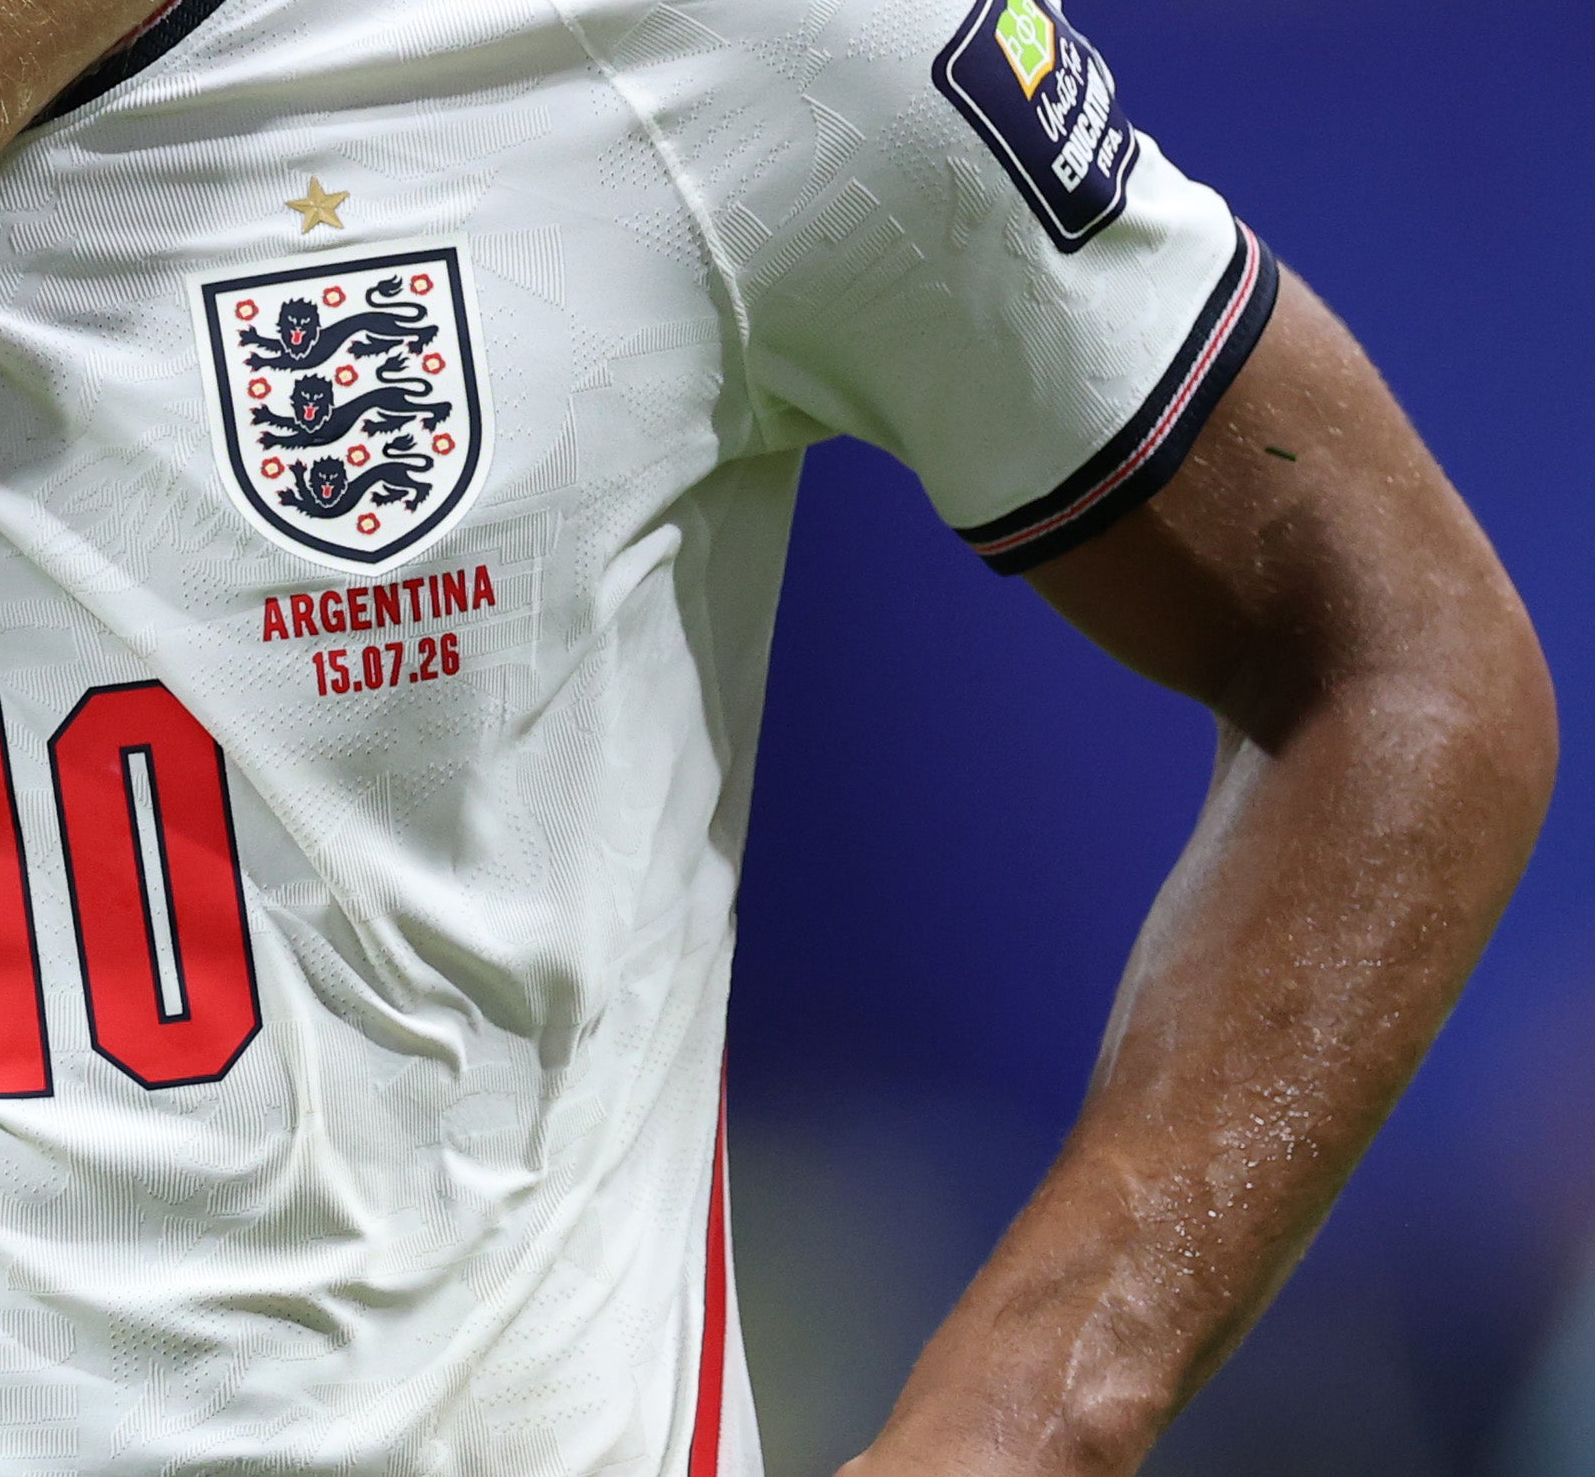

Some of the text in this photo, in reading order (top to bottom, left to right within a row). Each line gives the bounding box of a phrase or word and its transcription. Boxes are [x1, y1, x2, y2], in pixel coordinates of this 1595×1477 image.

[1097, 127, 1122, 179] FIFA
[262, 564, 496, 642] ARGENTINA
[313, 633, 460, 696] 15.07.26
